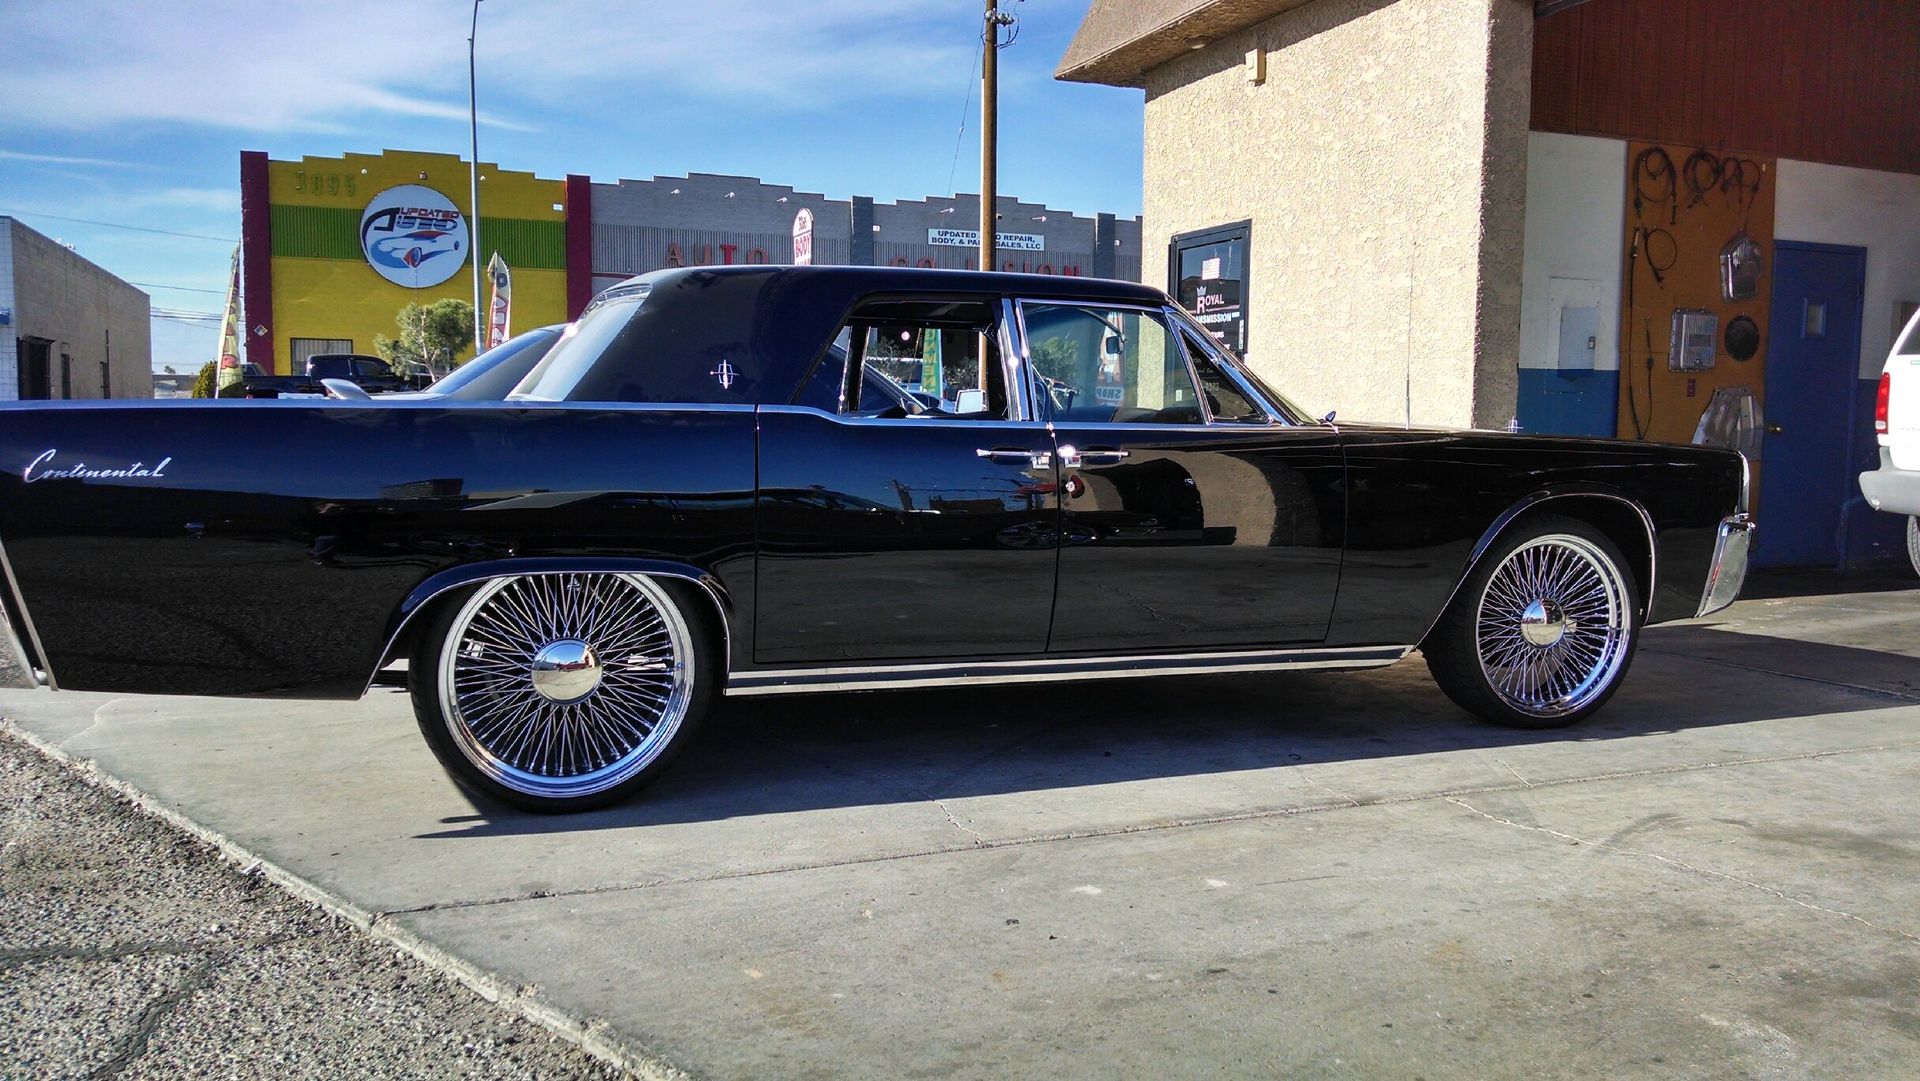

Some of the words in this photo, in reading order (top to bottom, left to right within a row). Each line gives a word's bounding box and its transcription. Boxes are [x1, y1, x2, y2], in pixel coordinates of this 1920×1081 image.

[296, 170, 356, 197] 3095
[400, 207, 460, 219] UPDATED
[931, 237, 956, 245] BODY,
[938, 230, 977, 239] UPDATED
[1003, 235, 1036, 243] REPAIR,
[666, 241, 769, 267] AUTO
[1197, 294, 1224, 314] ROYAL
[24, 449, 172, 484] Continental
